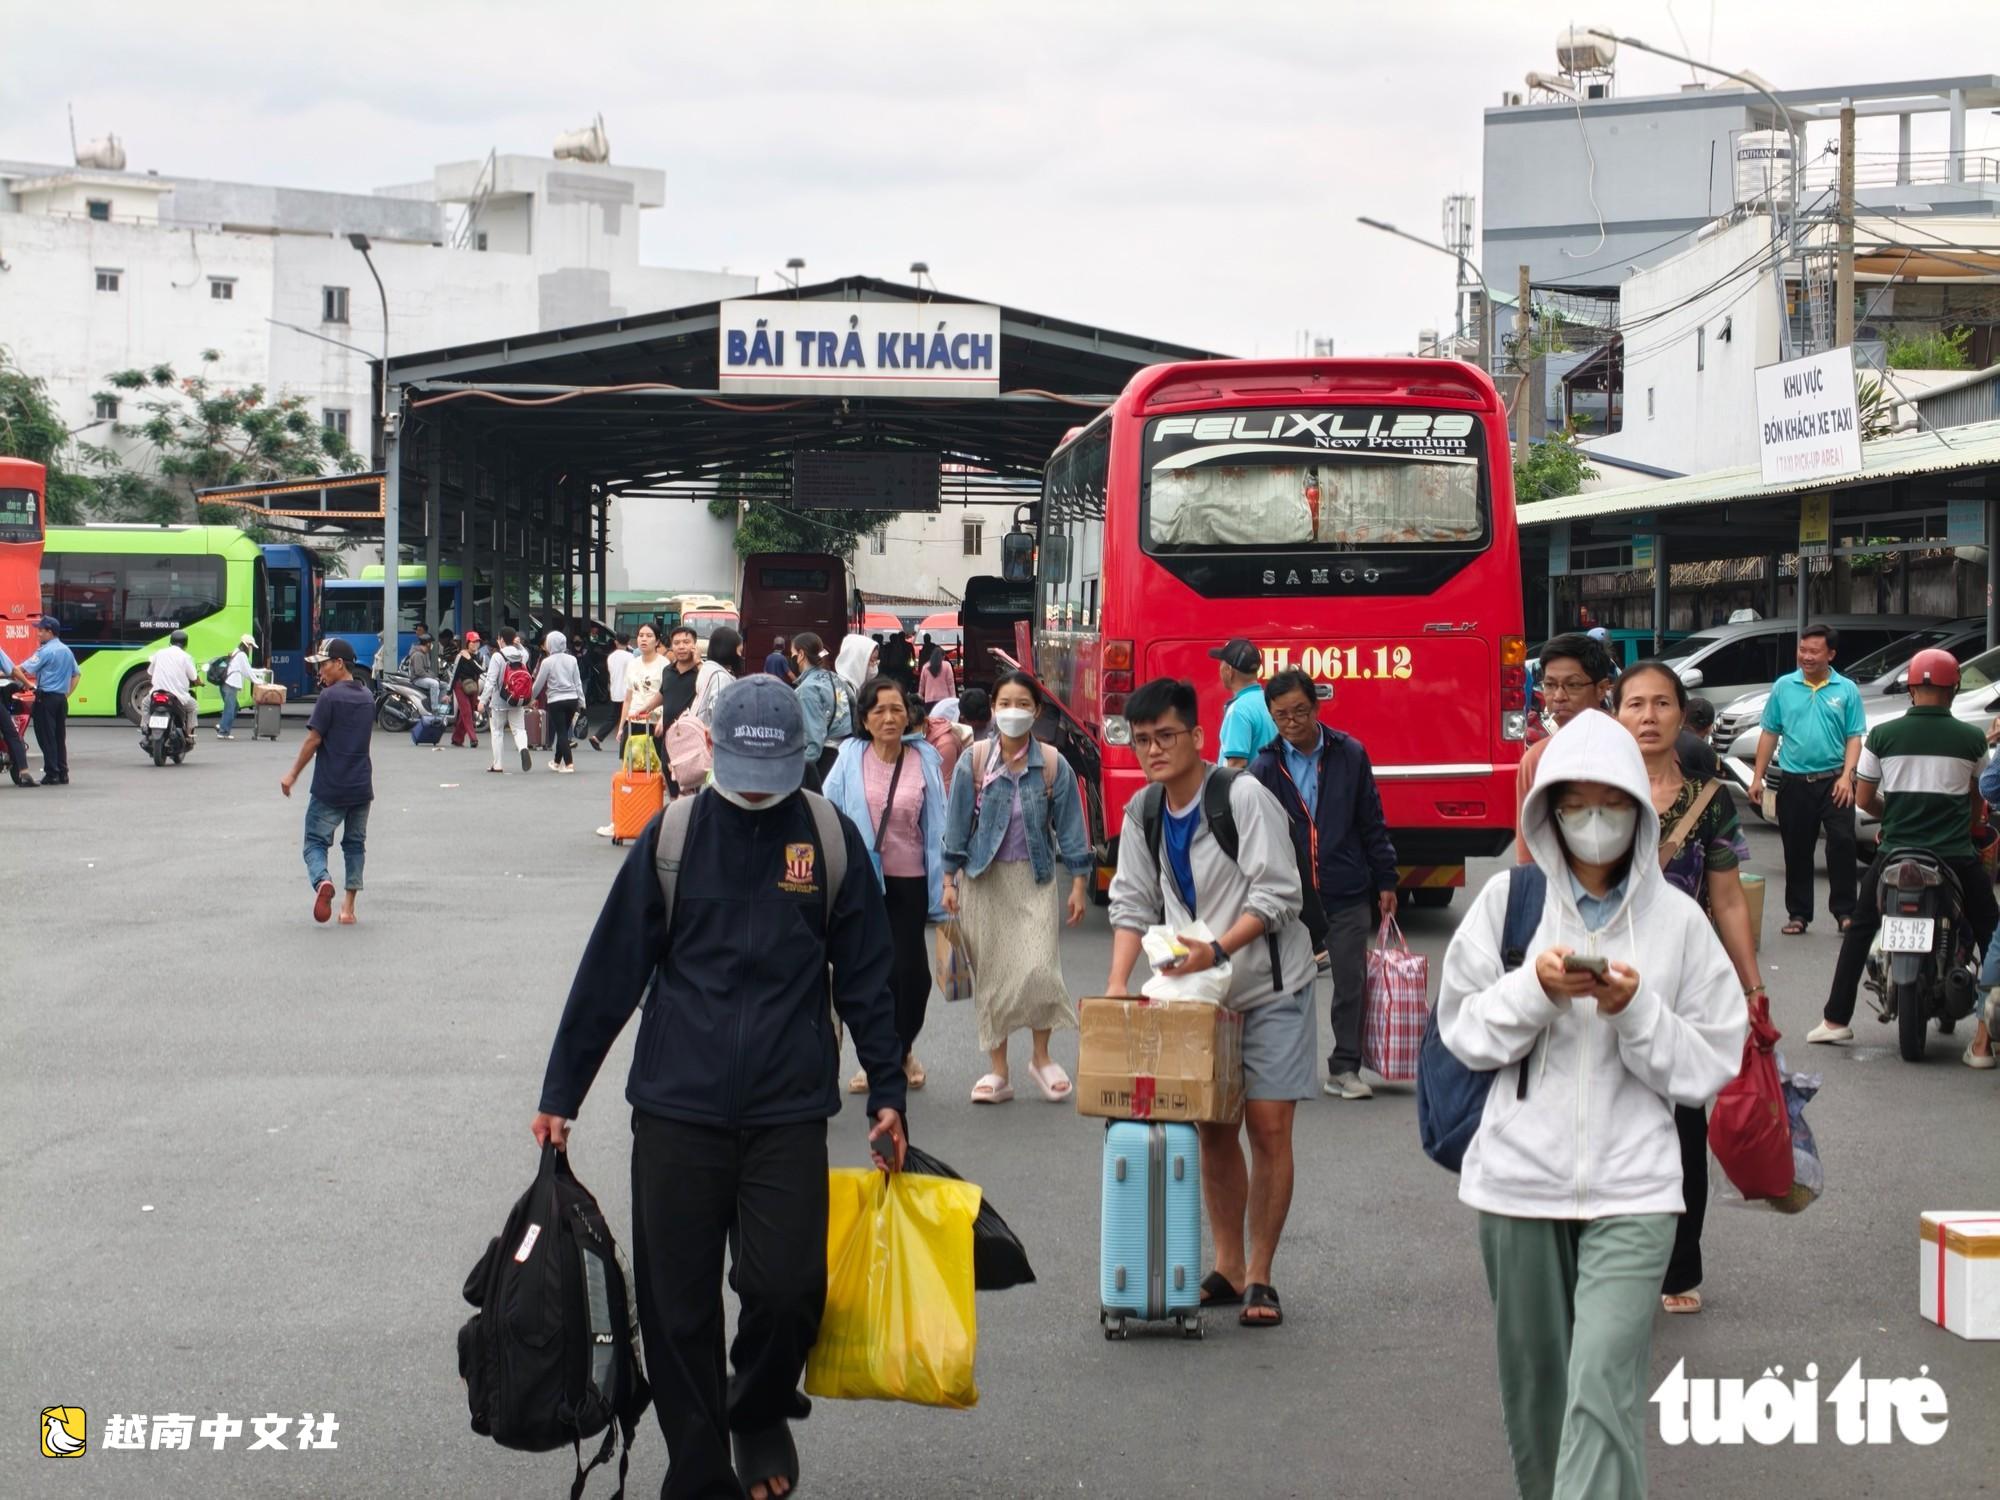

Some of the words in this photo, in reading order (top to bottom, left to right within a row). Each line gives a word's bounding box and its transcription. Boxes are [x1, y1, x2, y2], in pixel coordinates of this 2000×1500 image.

[727, 318, 784, 366] BÃI
[796, 314, 865, 368] TRẢ
[877, 321, 993, 370] KHÁCH
[1783, 371, 1802, 399] KHU
[1803, 365, 1824, 399] VỰC
[1764, 415, 1784, 445] ĐÓN
[1784, 410, 1816, 441] KHÁCH
[1817, 411, 1831, 435] XE
[1831, 407, 1853, 433] TAXI
[1314, 437, 1361, 448] New
[1367, 437, 1467, 448] Premium
[1412, 448, 1466, 456] NOBLE
[1262, 568, 1380, 585] SAMCO
[1889, 935, 1926, 950] 3232
